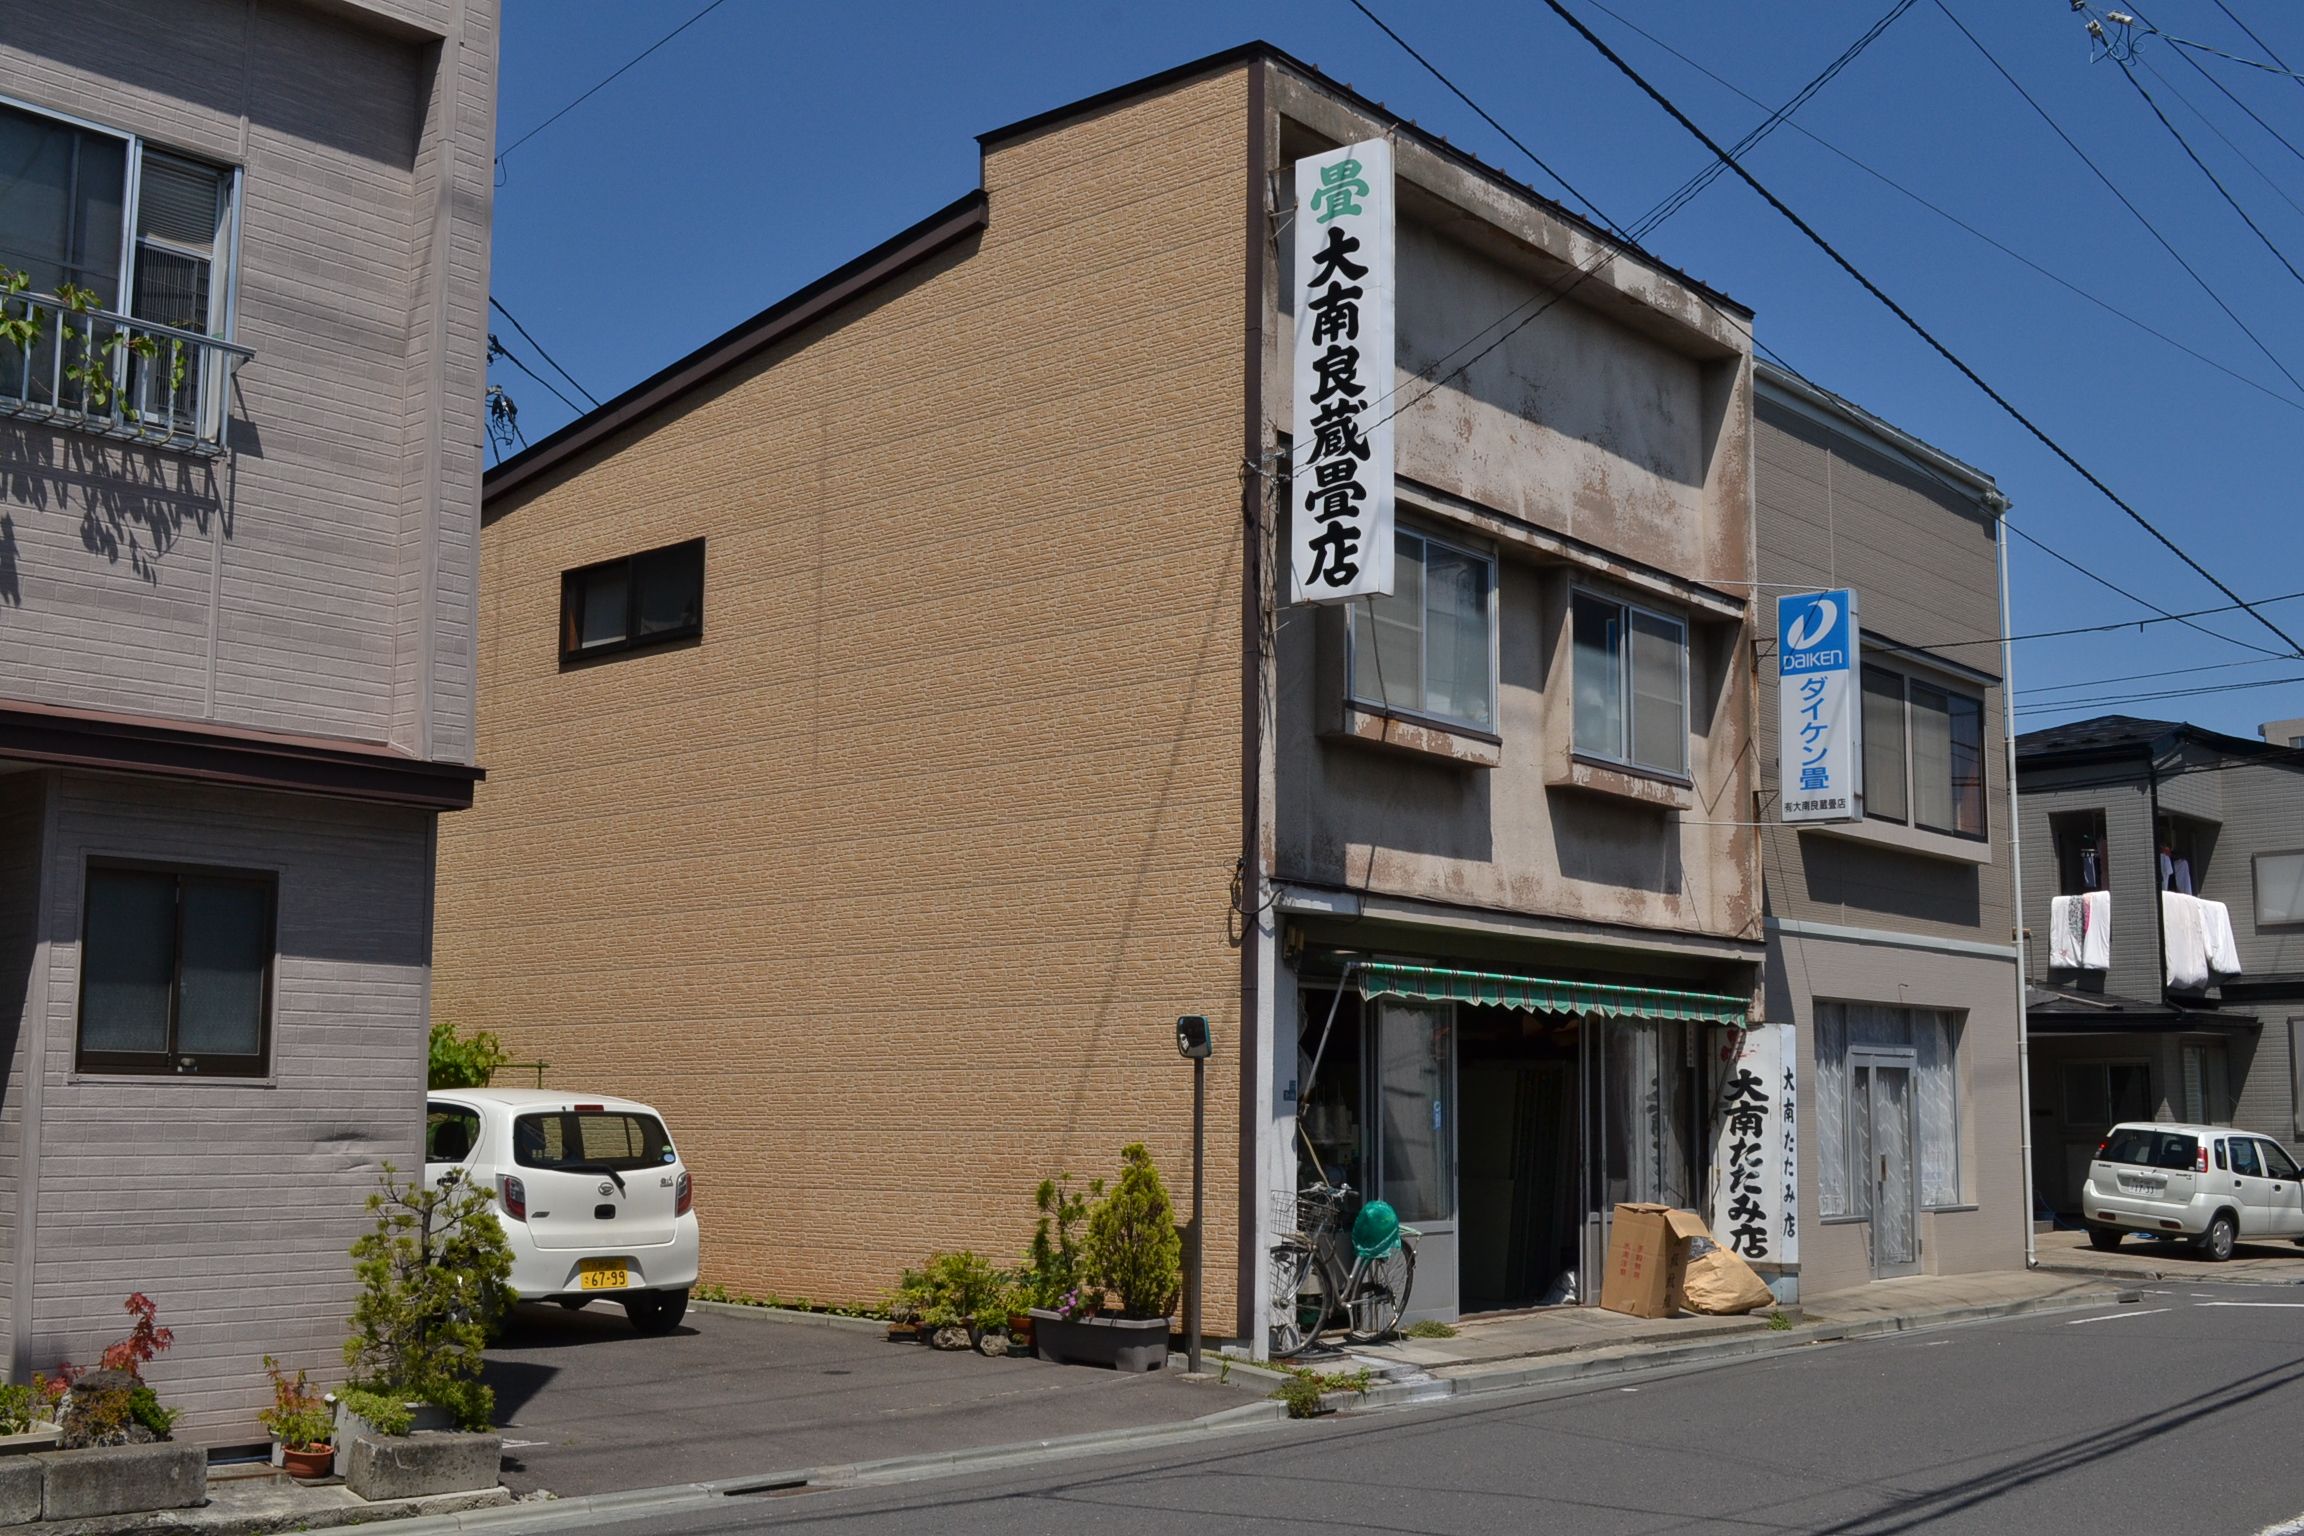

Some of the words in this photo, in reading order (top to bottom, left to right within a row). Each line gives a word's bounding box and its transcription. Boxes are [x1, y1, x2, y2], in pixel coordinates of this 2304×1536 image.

[1310, 157, 1370, 225] 畳
[1304, 227, 1370, 587] 大南良蔵畳店
[1800, 676, 1830, 790] ダイケン畳
[1724, 1069, 1769, 1259] 大南たたみ店
[1783, 1066, 1796, 1238] 大南たたみ店
